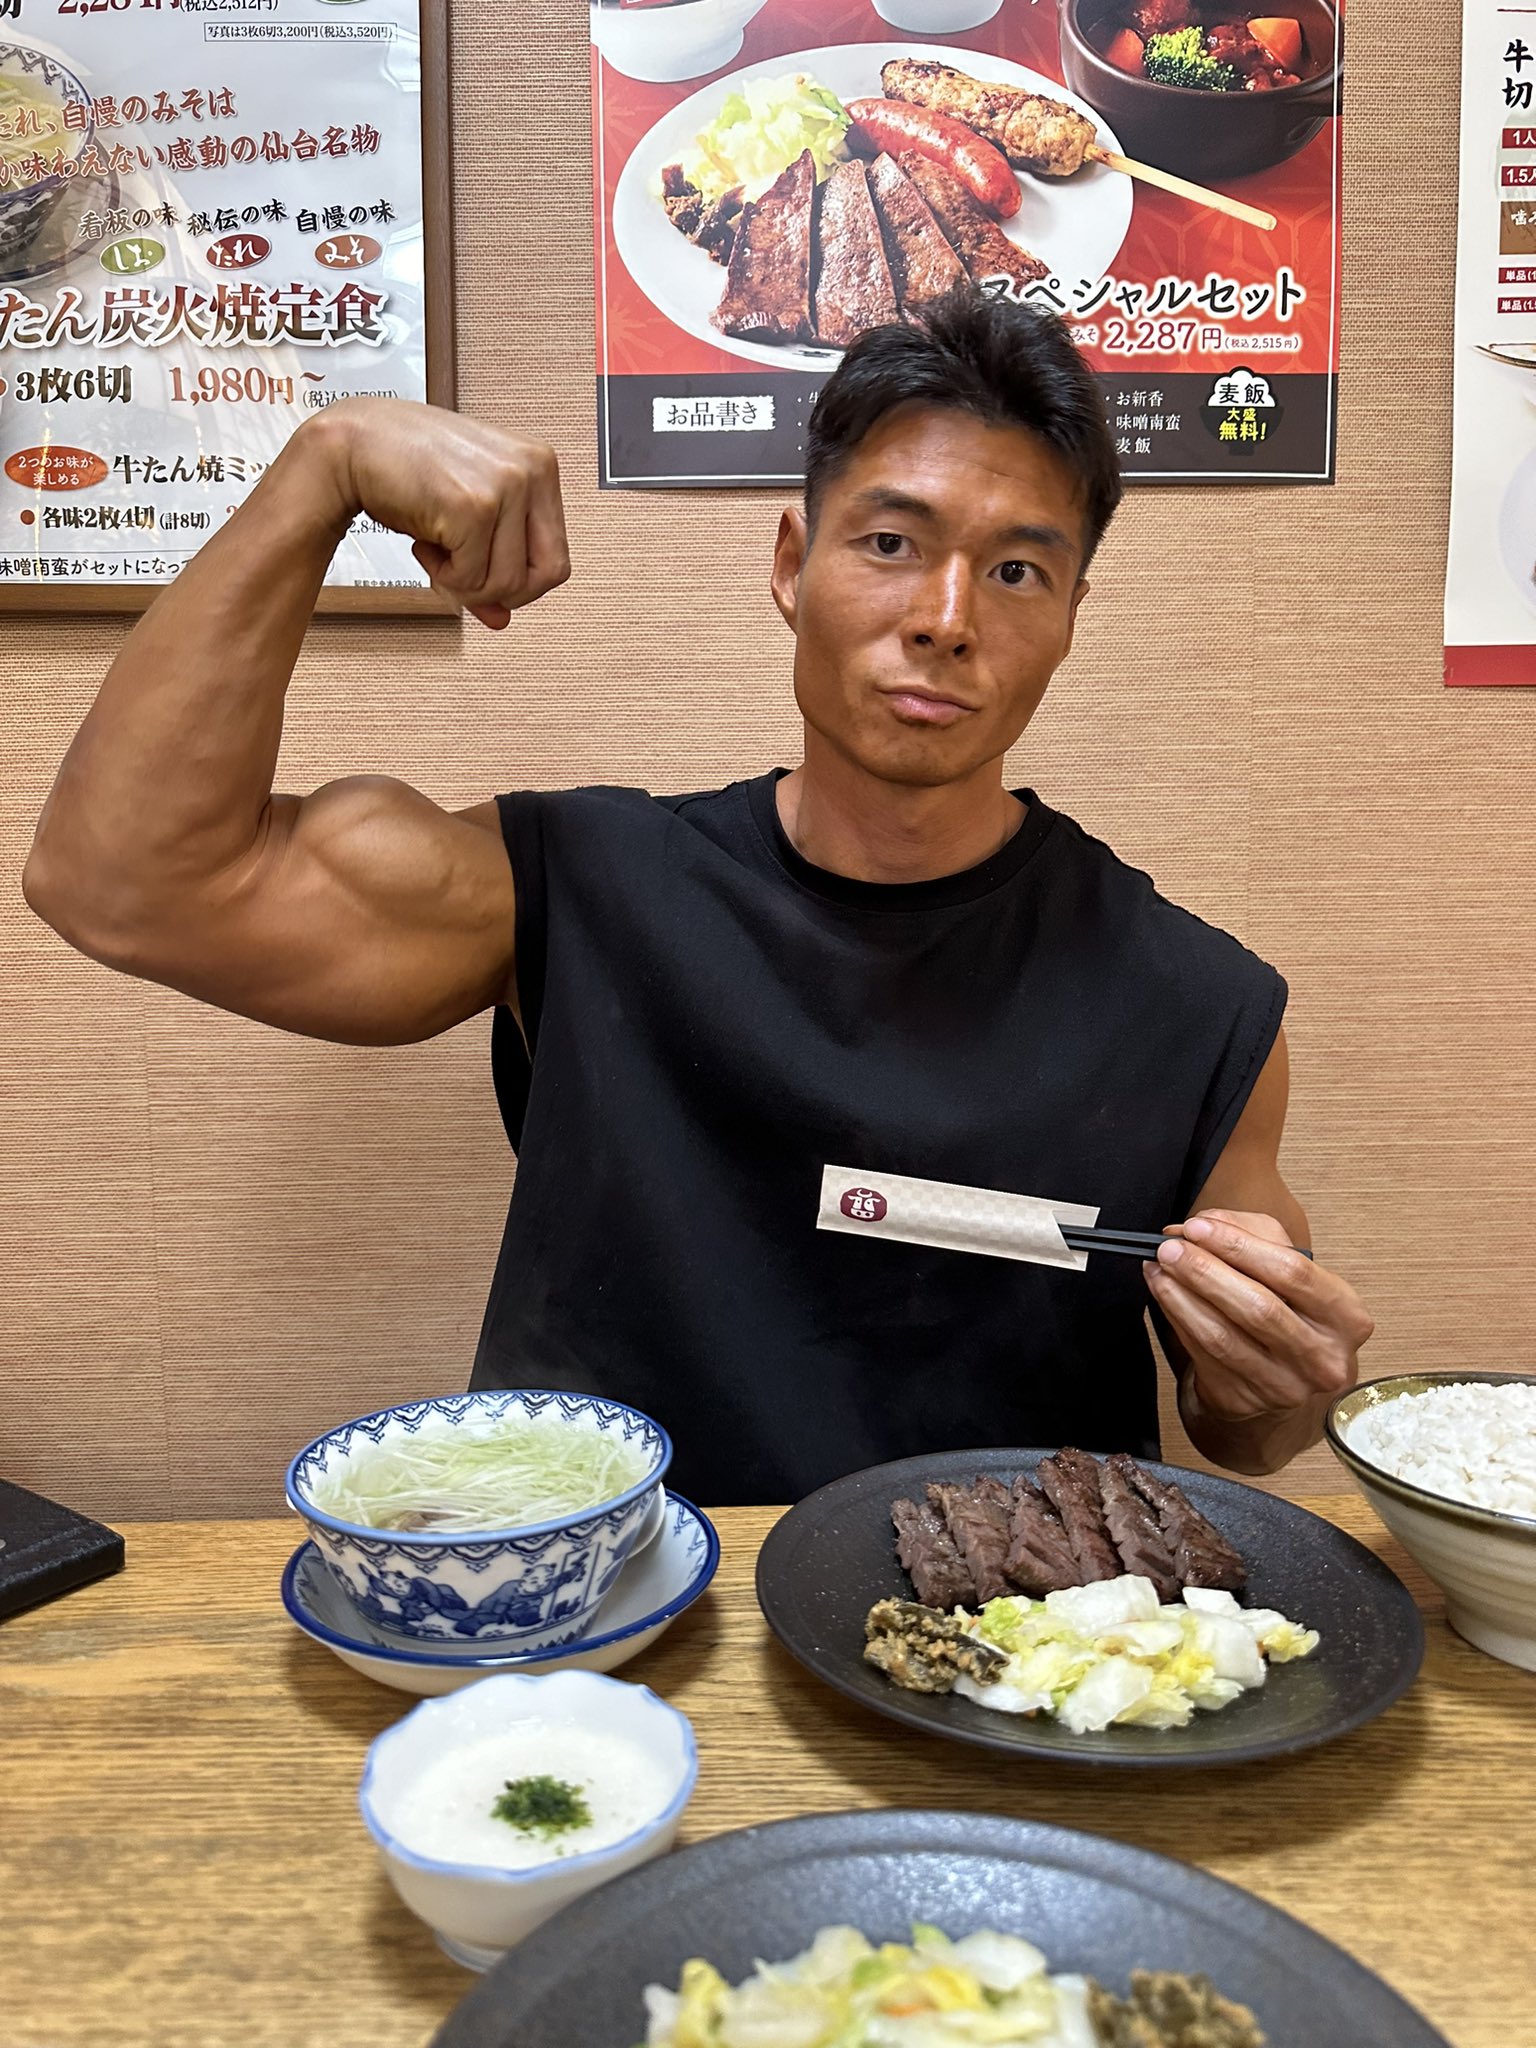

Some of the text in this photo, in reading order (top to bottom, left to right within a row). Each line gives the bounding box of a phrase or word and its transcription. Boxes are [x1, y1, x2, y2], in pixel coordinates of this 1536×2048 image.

[1503, 39, 1533, 72] 牛
[1502, 77, 1533, 109] 切
[79, 198, 395, 239] 看板の味 秘伝の味 自慢の味
[212, 238, 263, 268] たれ
[1501, 300, 1536, 311] 単品(1.
[16, 366, 132, 404] 3枚6切
[1219, 383, 1266, 404] 麦飯
[1116, 391, 1164, 407] お新香
[667, 401, 757, 427] お品書き
[1116, 414, 1181, 431] 味噌南蛮
[1227, 408, 1257, 421] 大盛
[1115, 437, 1151, 454] 麦飯
[18, 456, 94, 468] 2つのお味が
[33, 473, 80, 486] 楽しめる
